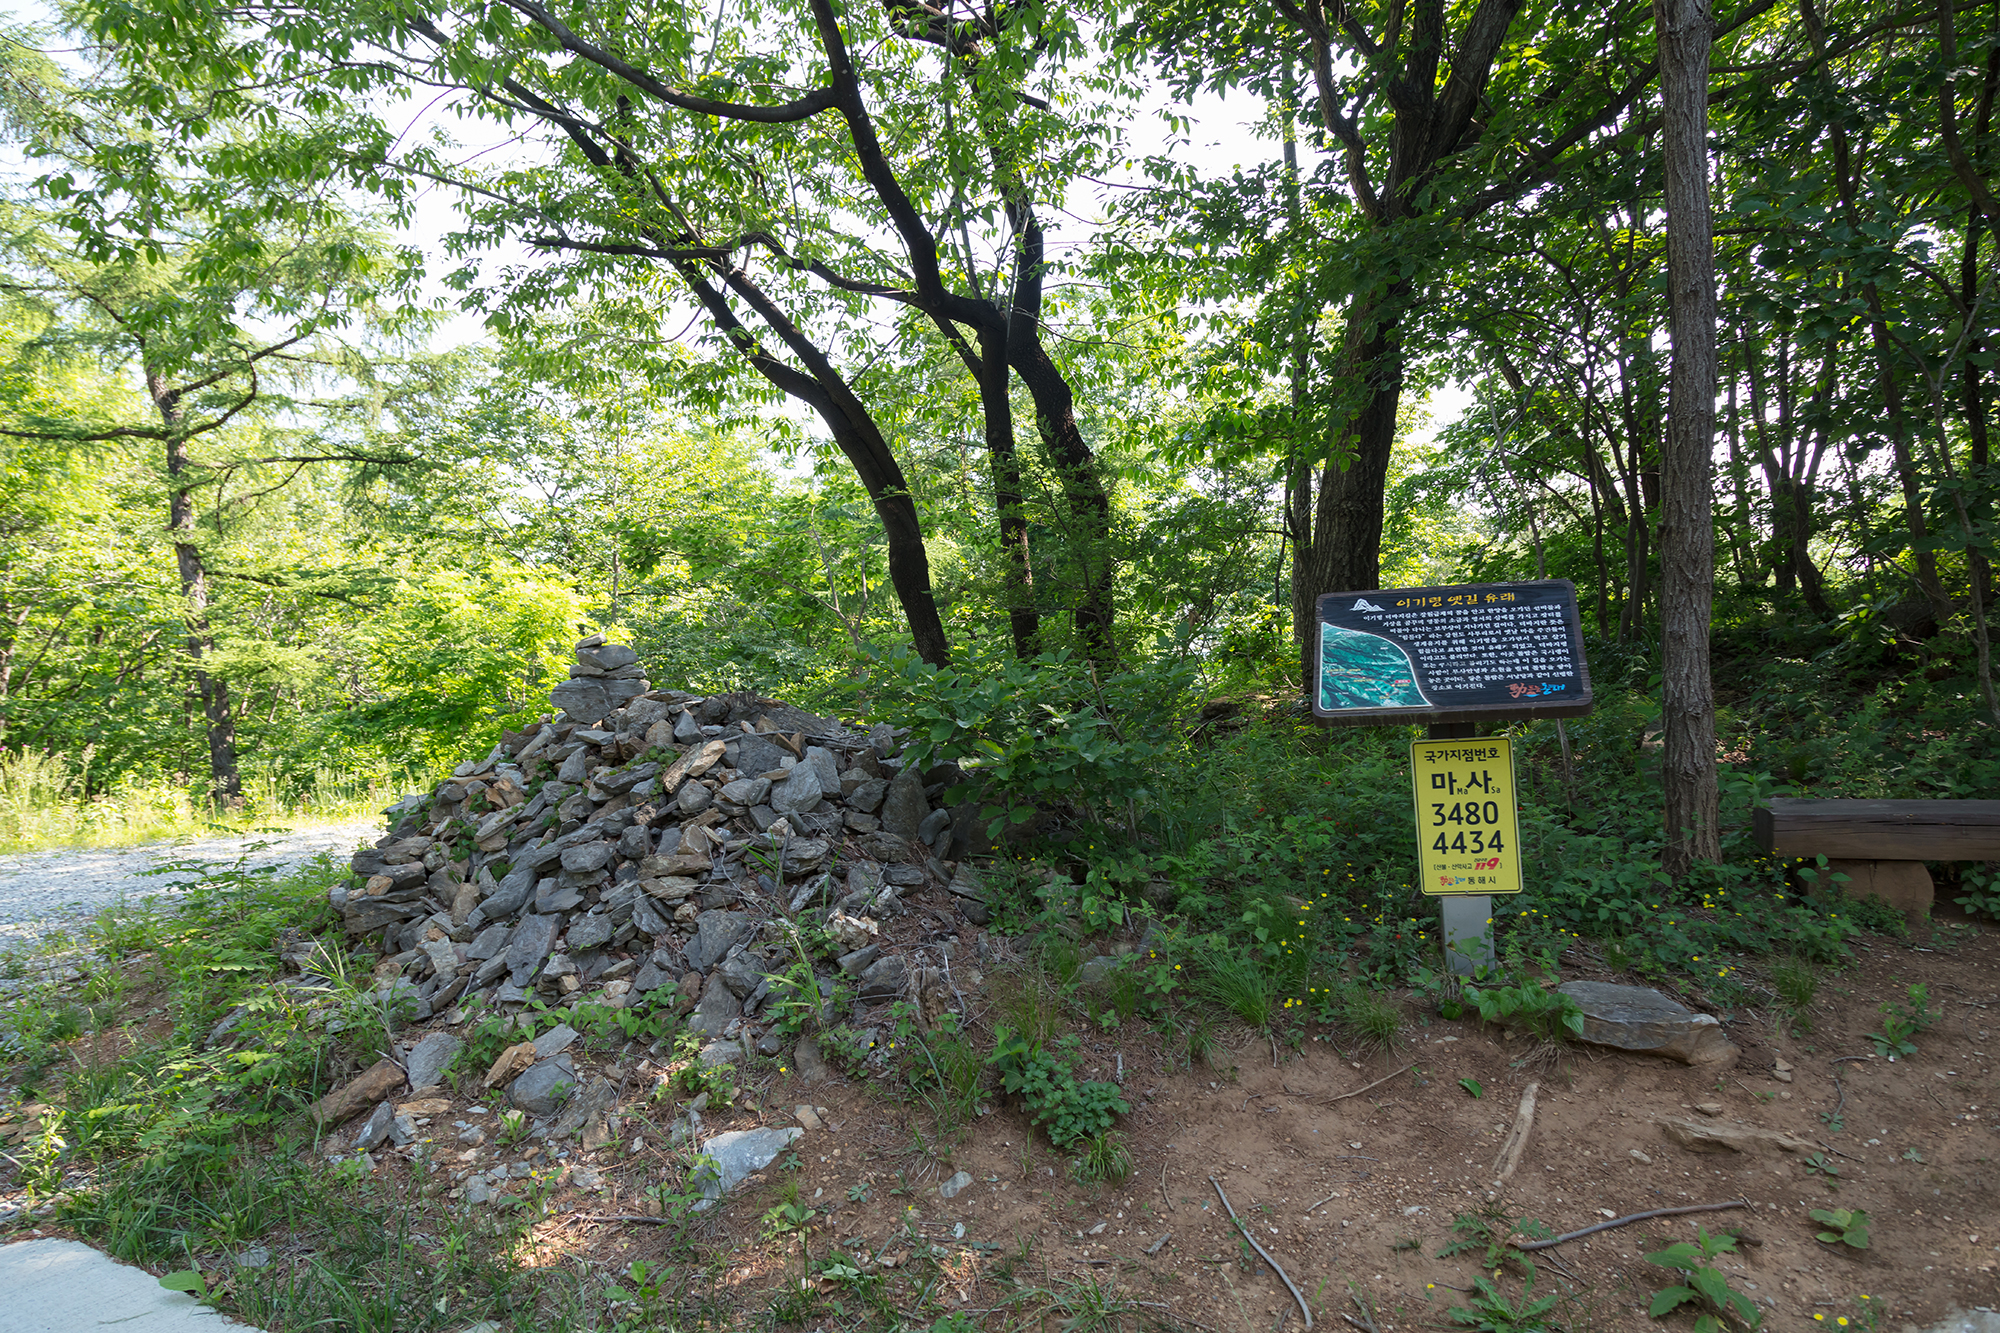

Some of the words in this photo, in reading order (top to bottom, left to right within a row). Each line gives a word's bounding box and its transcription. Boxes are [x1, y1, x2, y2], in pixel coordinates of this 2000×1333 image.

[1396, 596, 1442, 608] 이기령
[1448, 594, 1478, 606] 옛길
[1484, 592, 1515, 604] 유래
[1424, 748, 1500, 764] 국가지점번호
[1432, 772, 1457, 795] 마
[1466, 770, 1492, 794] 사
[1432, 801, 1498, 826] 3480
[1432, 830, 1504, 854] 4434
